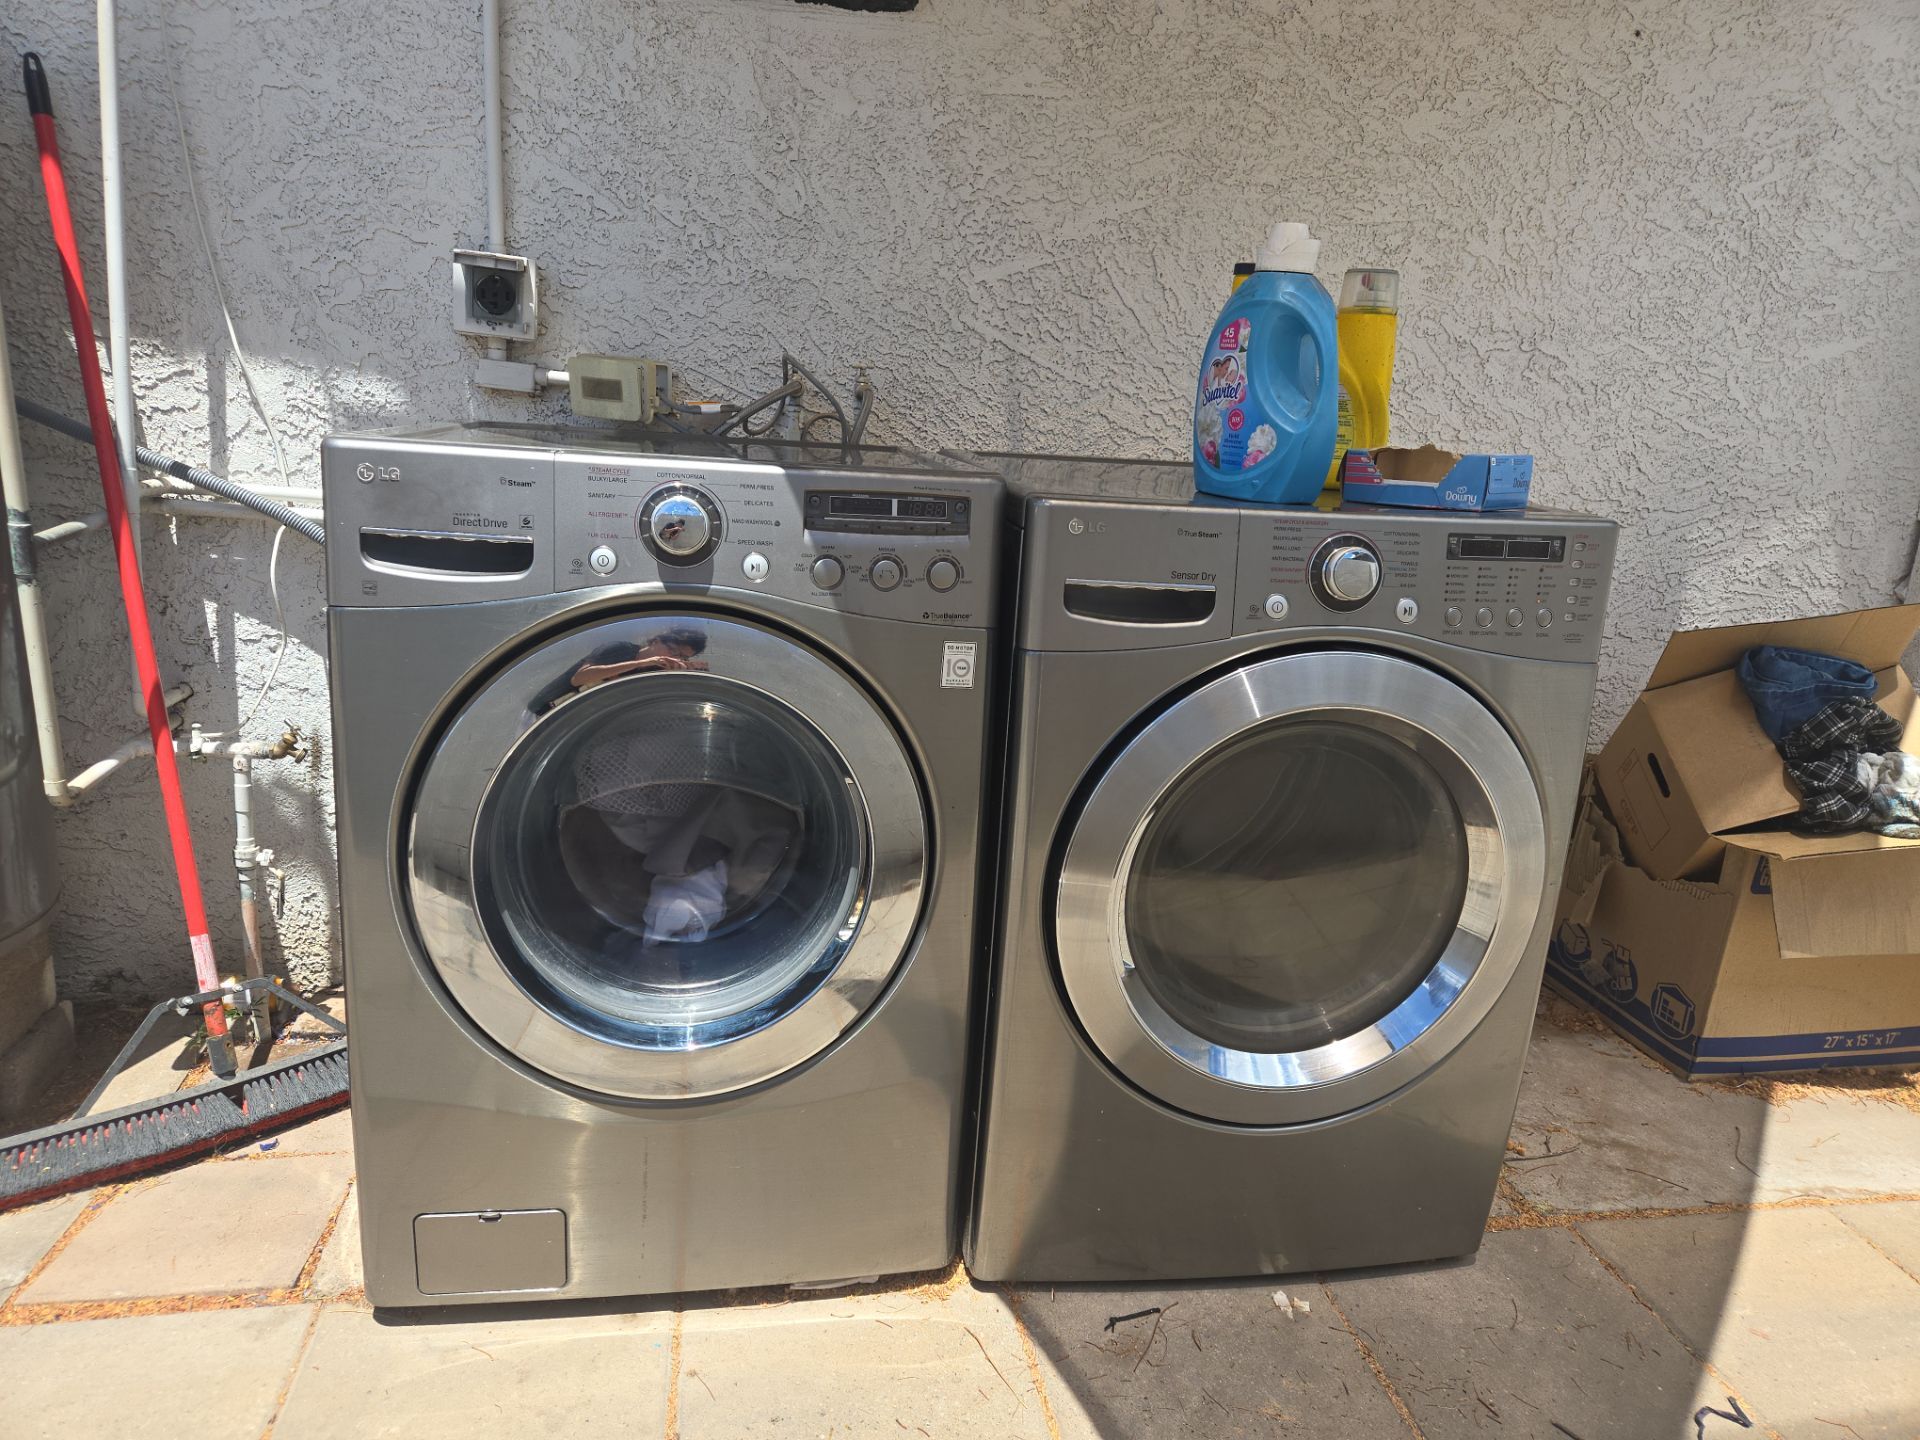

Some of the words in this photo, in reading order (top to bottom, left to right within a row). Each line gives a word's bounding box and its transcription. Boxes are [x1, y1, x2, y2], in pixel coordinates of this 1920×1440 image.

[1224, 328, 1235, 338] 45
[1202, 382, 1241, 407] Suavitel
[378, 466, 400, 482] LG
[1445, 490, 1477, 505] Downy
[452, 516, 481, 528] Direct
[483, 518, 508, 529] Drive
[1087, 520, 1106, 533] LG
[1183, 530, 1197, 538] True
[1170, 570, 1200, 581] Sensor
[1201, 571, 1217, 583] Dry
[1823, 1035, 1845, 1049] 27"
[1845, 1038, 1854, 1048] x
[1856, 1033, 1874, 1047] 15"
[1875, 1036, 1882, 1045] x
